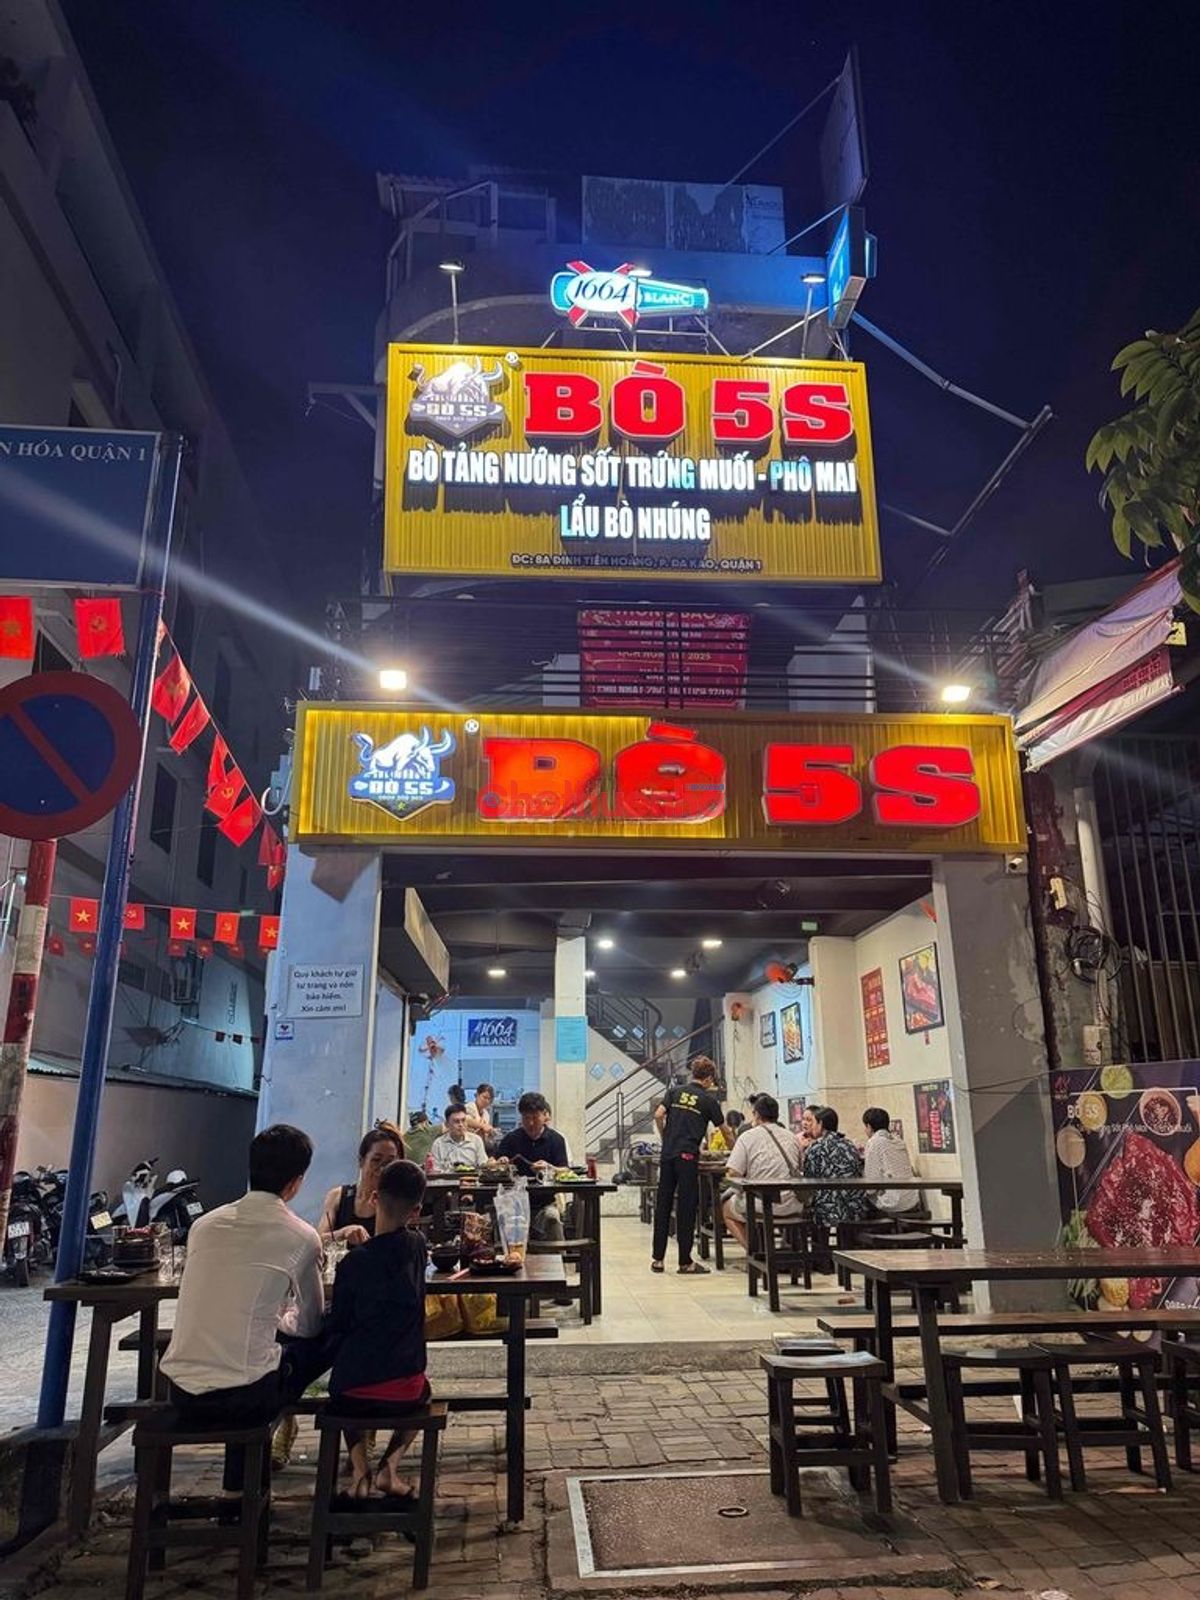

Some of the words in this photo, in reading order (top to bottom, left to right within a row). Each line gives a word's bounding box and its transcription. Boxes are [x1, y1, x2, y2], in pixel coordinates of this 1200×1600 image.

[574, 277, 631, 303] 1664
[524, 359, 685, 436] BÒ
[711, 378, 853, 442] 5S
[18, 440, 64, 458] HÓA
[71, 442, 131, 463] QUẬN
[139, 448, 145, 461] 1
[408, 442, 439, 481] BÒ
[443, 443, 500, 483] TẢNG
[581, 447, 621, 487] SỐT
[625, 450, 696, 489] TRỨNG
[699, 450, 756, 491] MUỐI
[769, 457, 812, 491] PHÔ
[815, 461, 858, 492] MAI
[560, 494, 600, 538] LẨU
[604, 500, 635, 538] BÒ
[637, 501, 711, 540] NHÚNG
[721, 559, 754, 573] QUẬN
[763, 744, 981, 826] 5S
